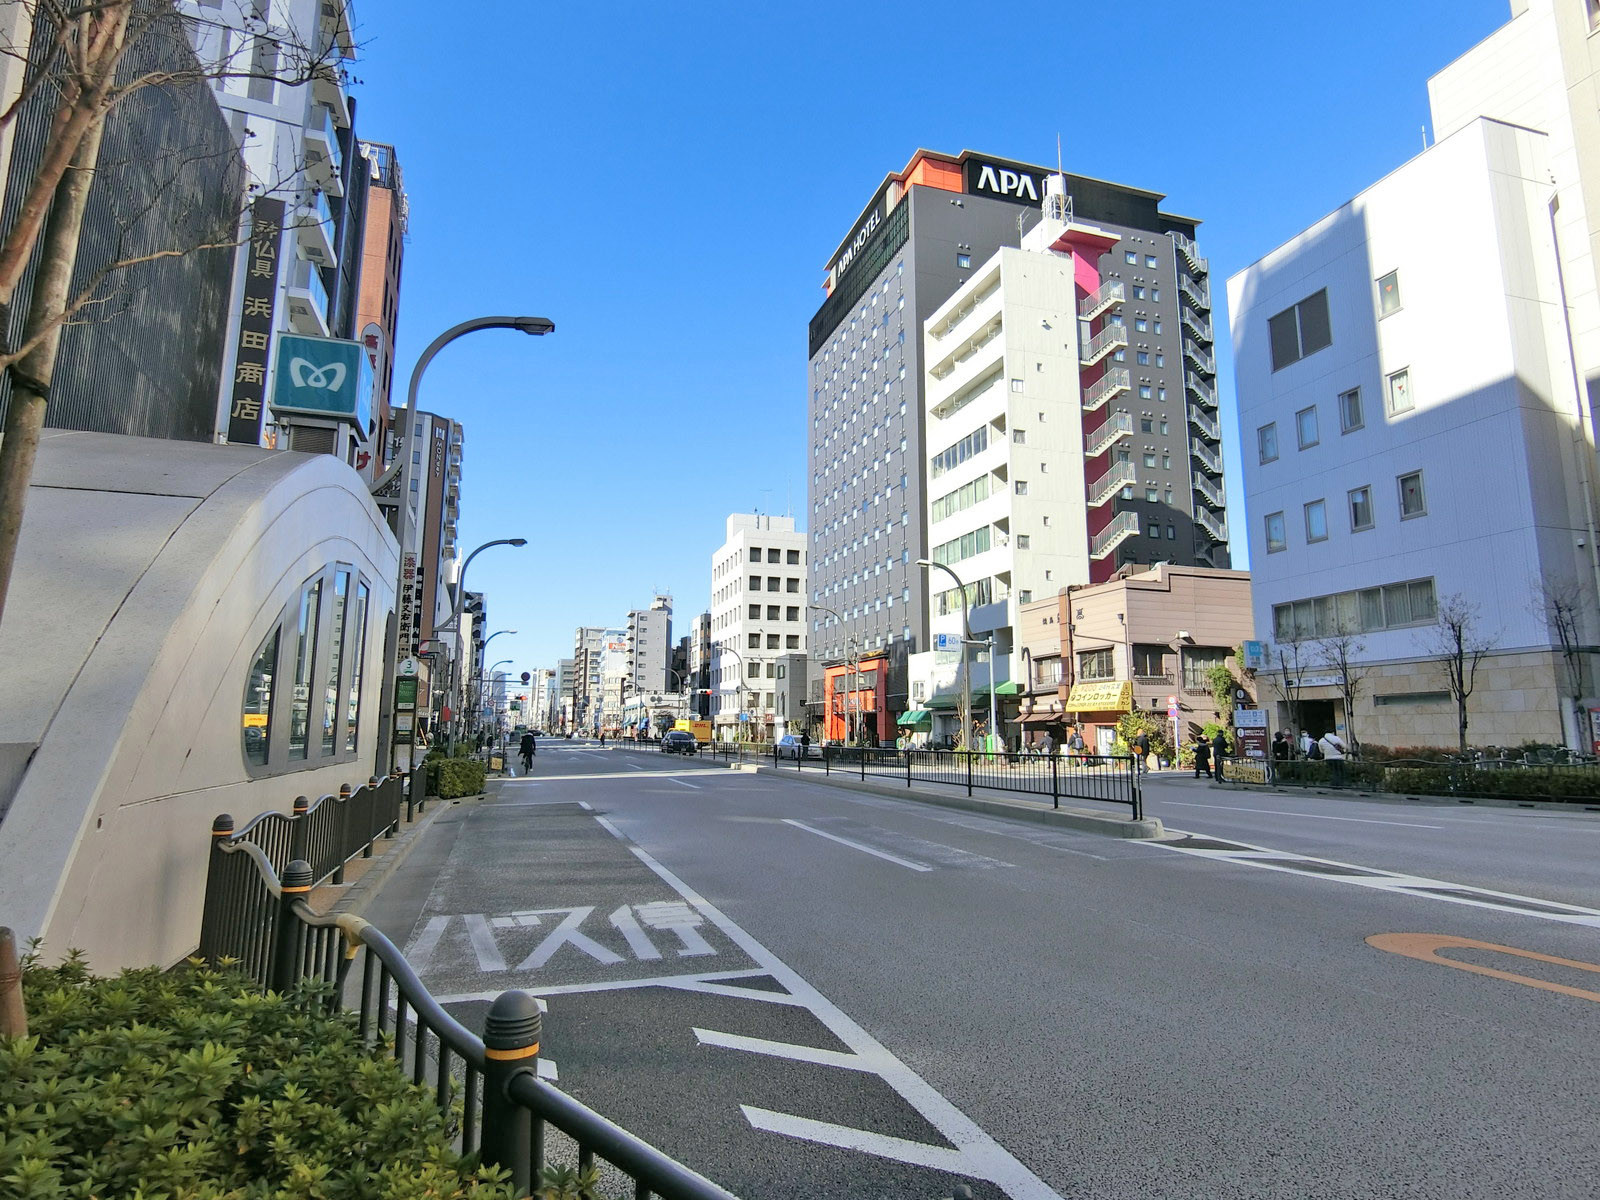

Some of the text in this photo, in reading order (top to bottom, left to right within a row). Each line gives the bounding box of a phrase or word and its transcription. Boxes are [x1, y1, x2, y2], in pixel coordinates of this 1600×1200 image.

[977, 165, 1038, 201] APA
[837, 208, 881, 278] APA HOTEL
[232, 296, 272, 421] 浜田商店
[407, 661, 412, 669] 3
[404, 900, 717, 973] バス停
